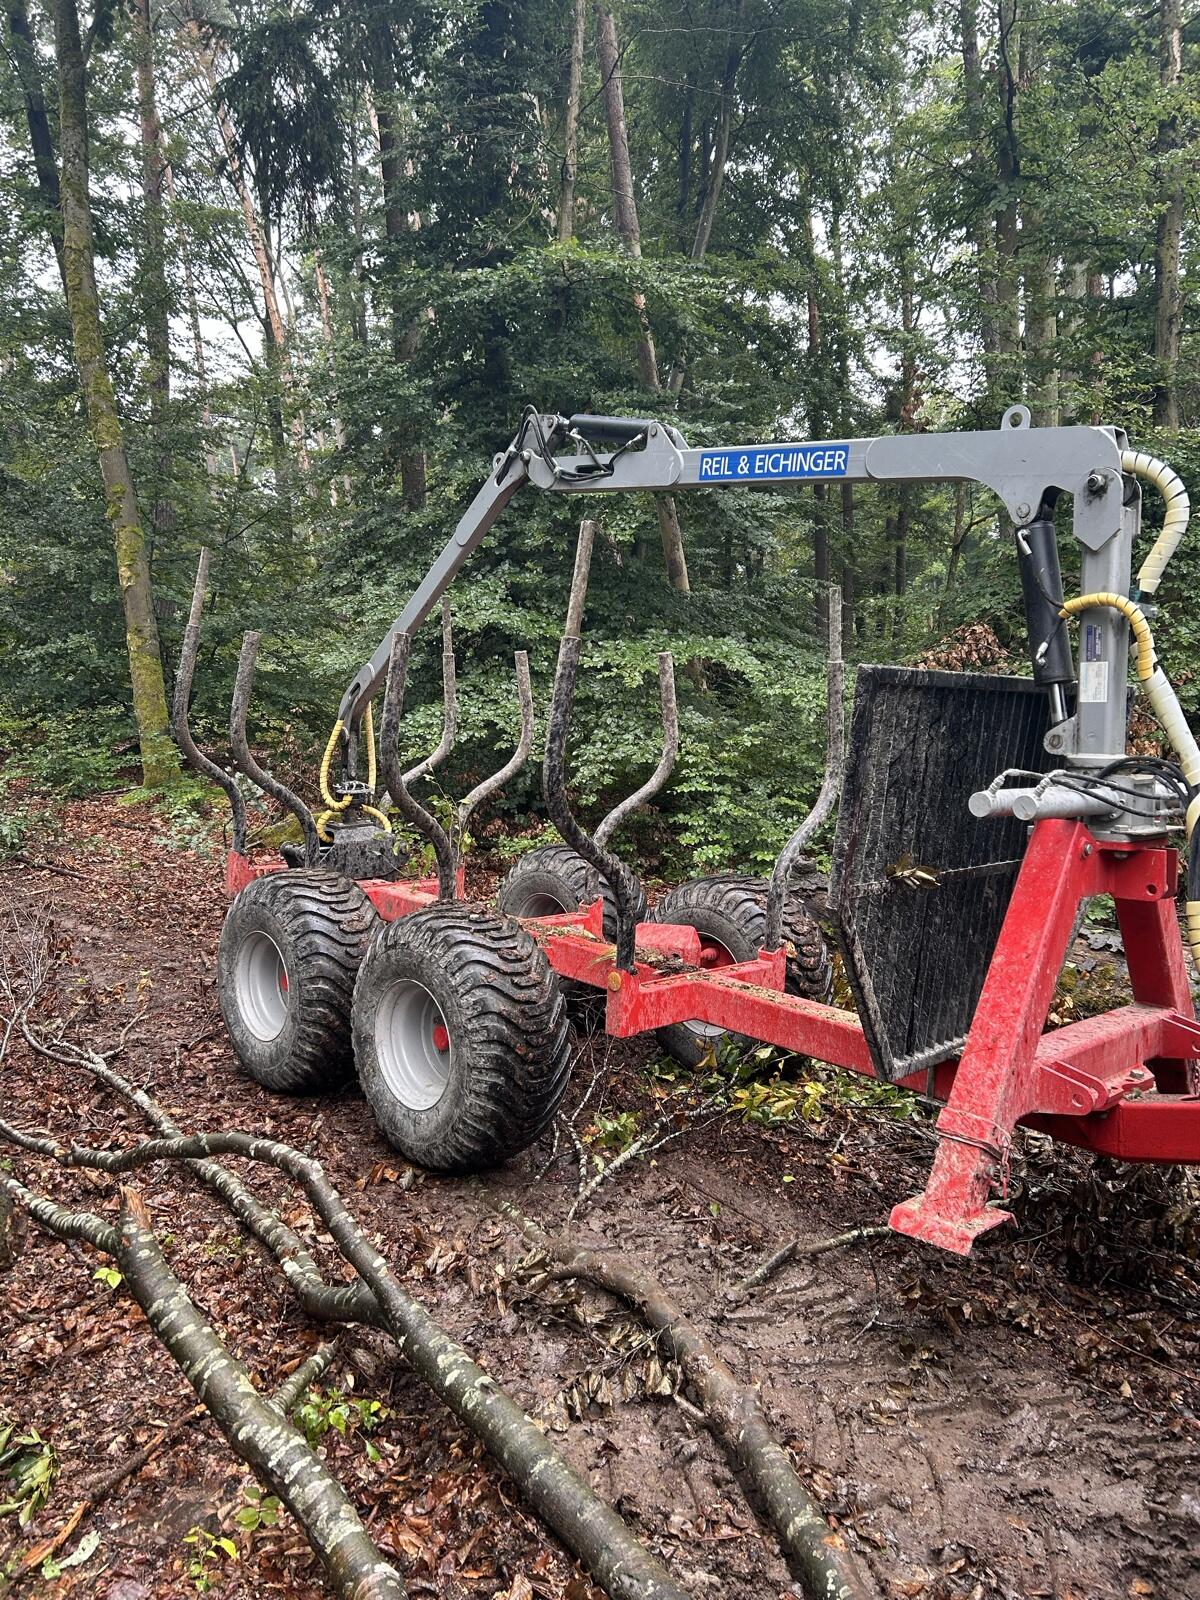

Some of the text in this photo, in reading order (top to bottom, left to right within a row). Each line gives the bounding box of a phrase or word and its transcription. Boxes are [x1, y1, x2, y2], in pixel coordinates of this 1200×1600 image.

[702, 450, 846, 476] REIL & EICHINGER
